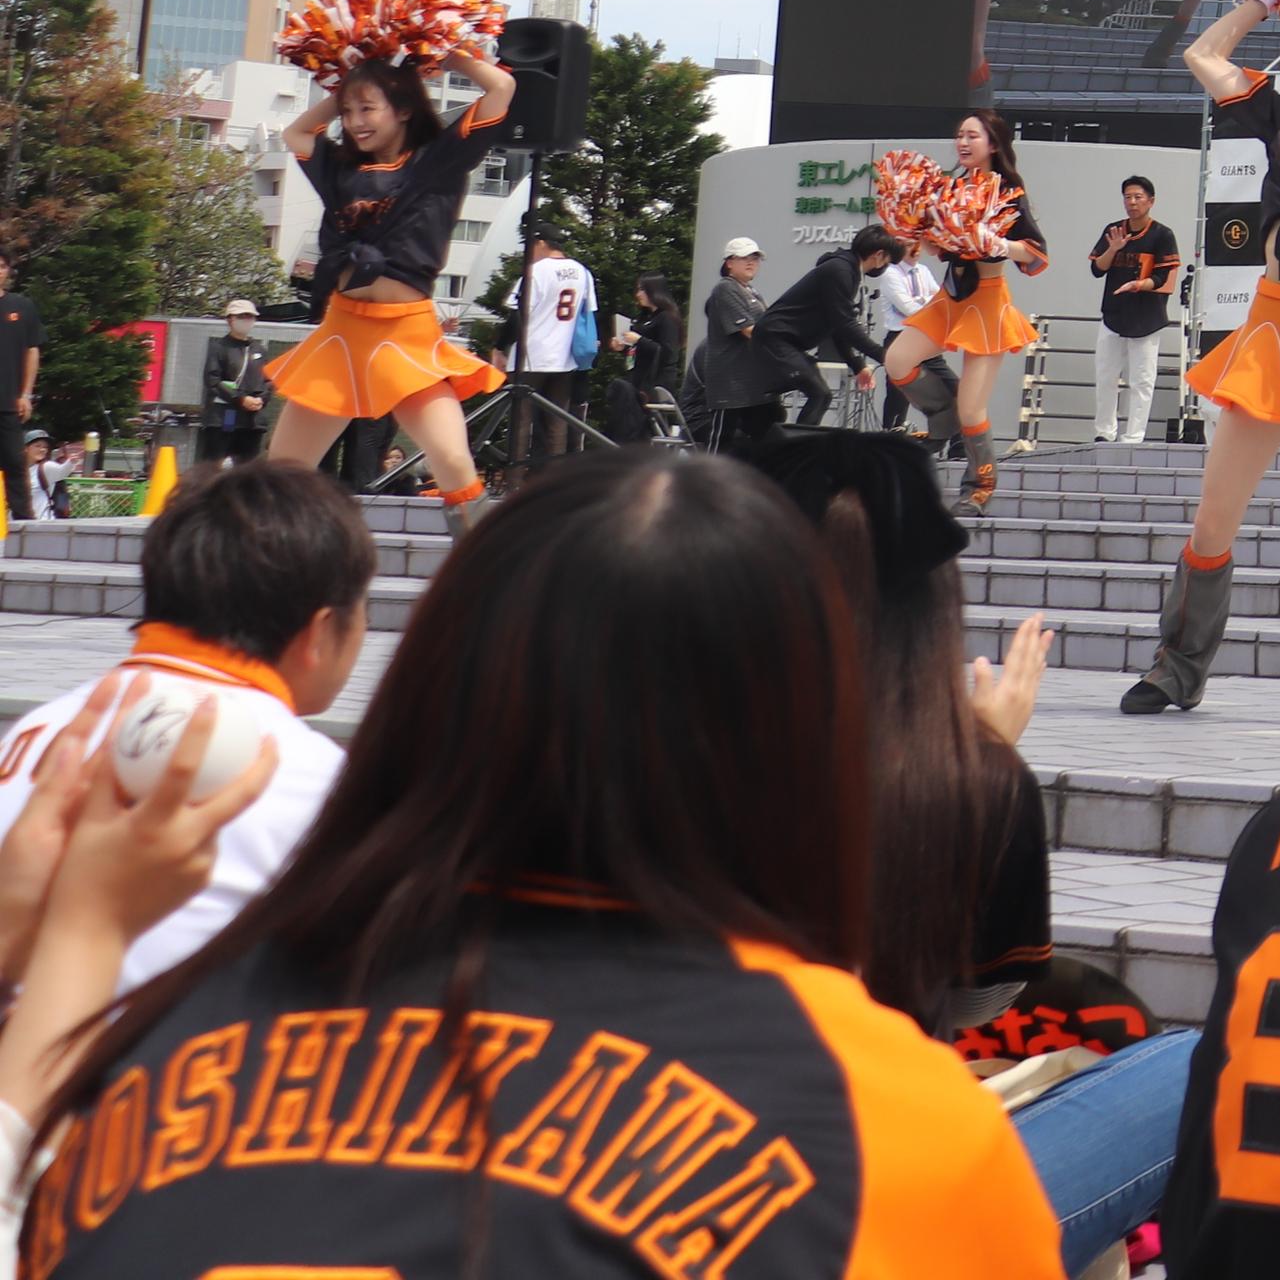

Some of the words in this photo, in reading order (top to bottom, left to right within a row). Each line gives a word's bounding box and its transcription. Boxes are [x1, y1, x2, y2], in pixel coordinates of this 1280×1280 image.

[1220, 165, 1256, 176] GIANTS
[1217, 292, 1249, 304] GIANTS
[556, 287, 577, 322] 8
